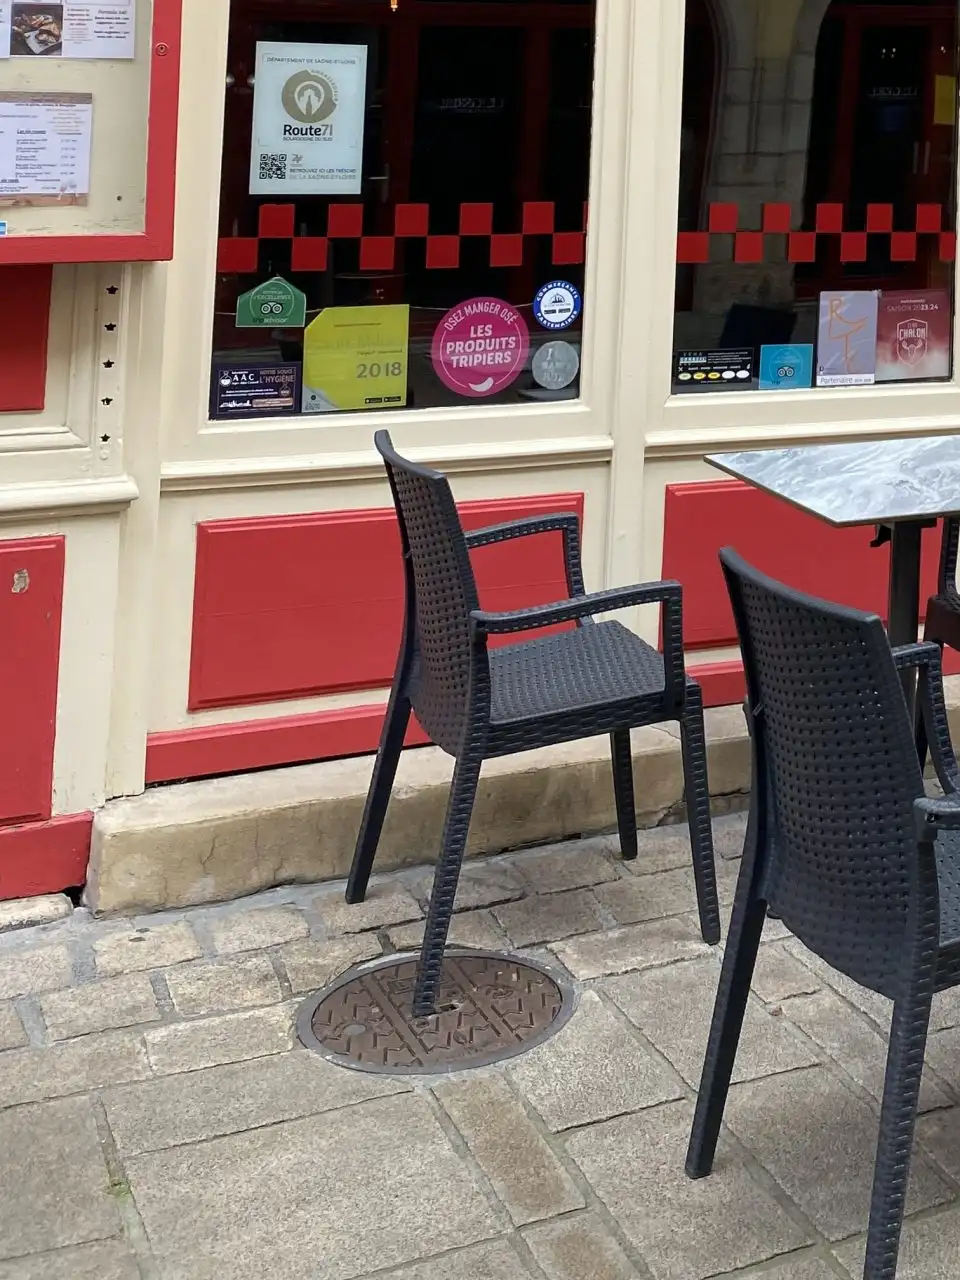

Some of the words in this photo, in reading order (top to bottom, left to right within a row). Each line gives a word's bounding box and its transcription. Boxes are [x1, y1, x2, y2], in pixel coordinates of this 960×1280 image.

[444, 309, 466, 331] OSEZ
[464, 302, 501, 317] MANGER
[500, 309, 519, 325] OSÉ
[470, 324, 493, 338] LES
[446, 337, 517, 354] PRODUITS
[451, 351, 513, 369] TRIPIERS
[356, 361, 402, 379] 2018
